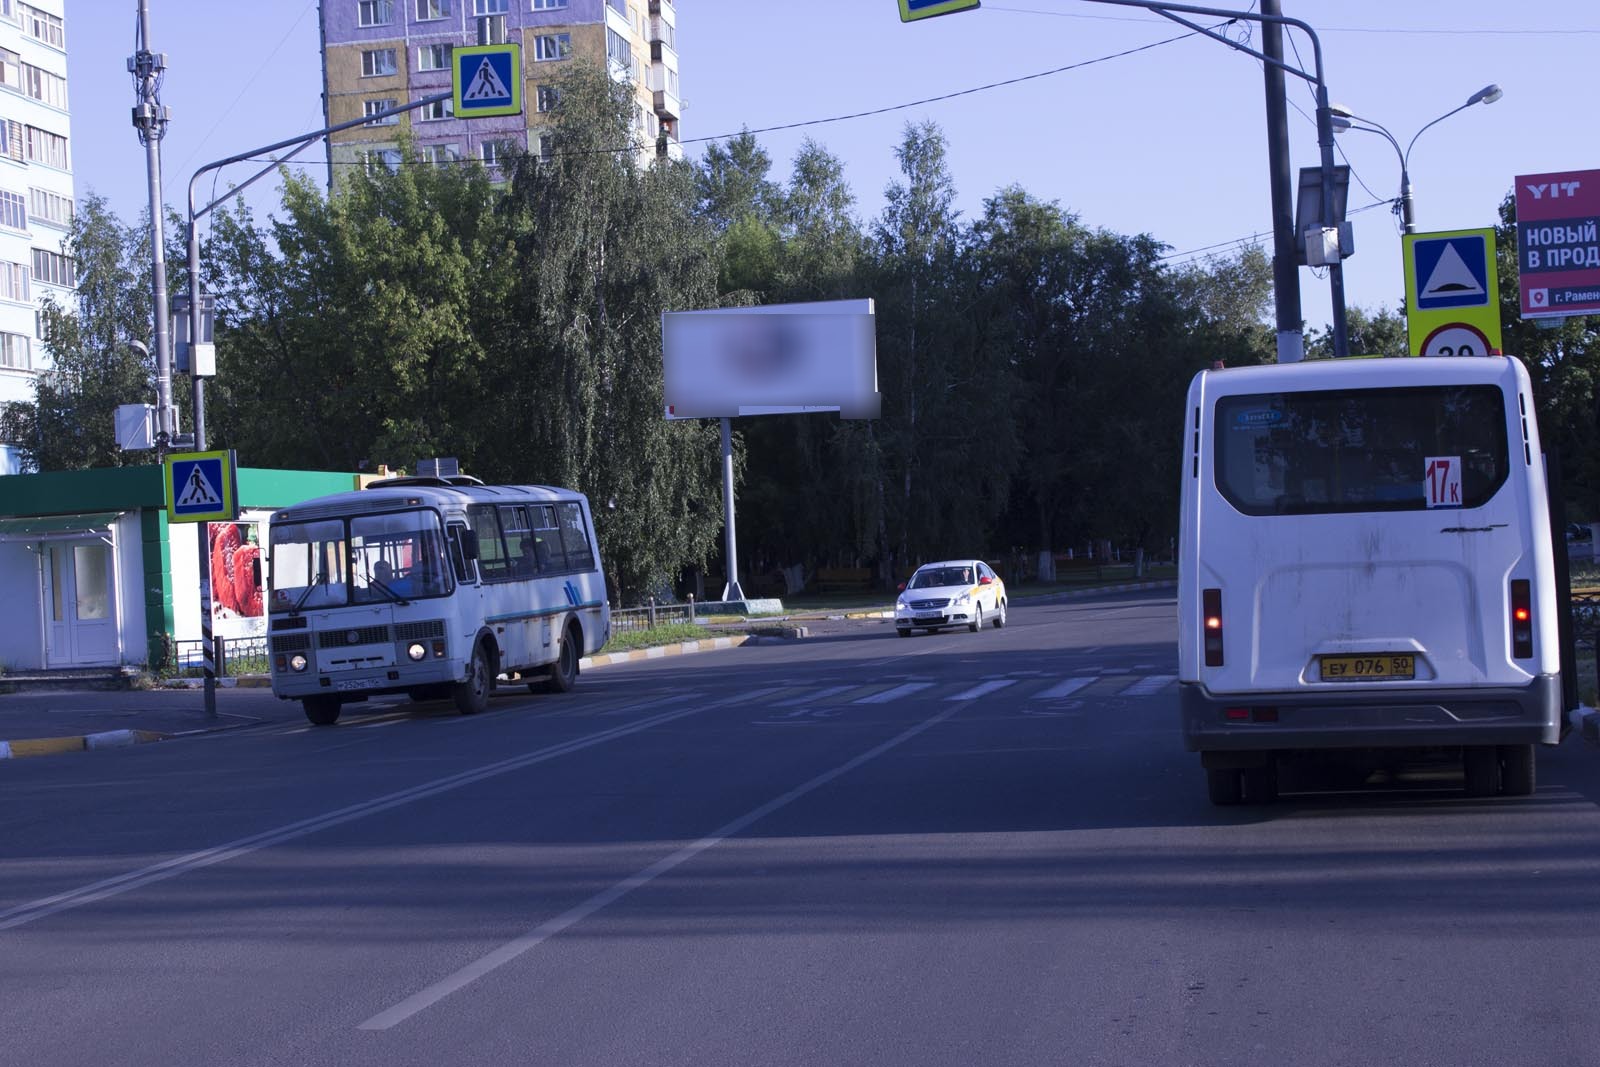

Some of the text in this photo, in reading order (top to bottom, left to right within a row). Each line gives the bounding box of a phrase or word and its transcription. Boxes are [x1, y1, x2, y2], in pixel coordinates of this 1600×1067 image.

[1526, 181, 1580, 199] YIT
[1527, 221, 1597, 246] НОВЫЙ
[1528, 246, 1600, 268] В ПРОД
[1555, 291, 1600, 303] г. Рамен
[1355, 660, 1384, 674] 076
[1393, 658, 1408, 669] 50
